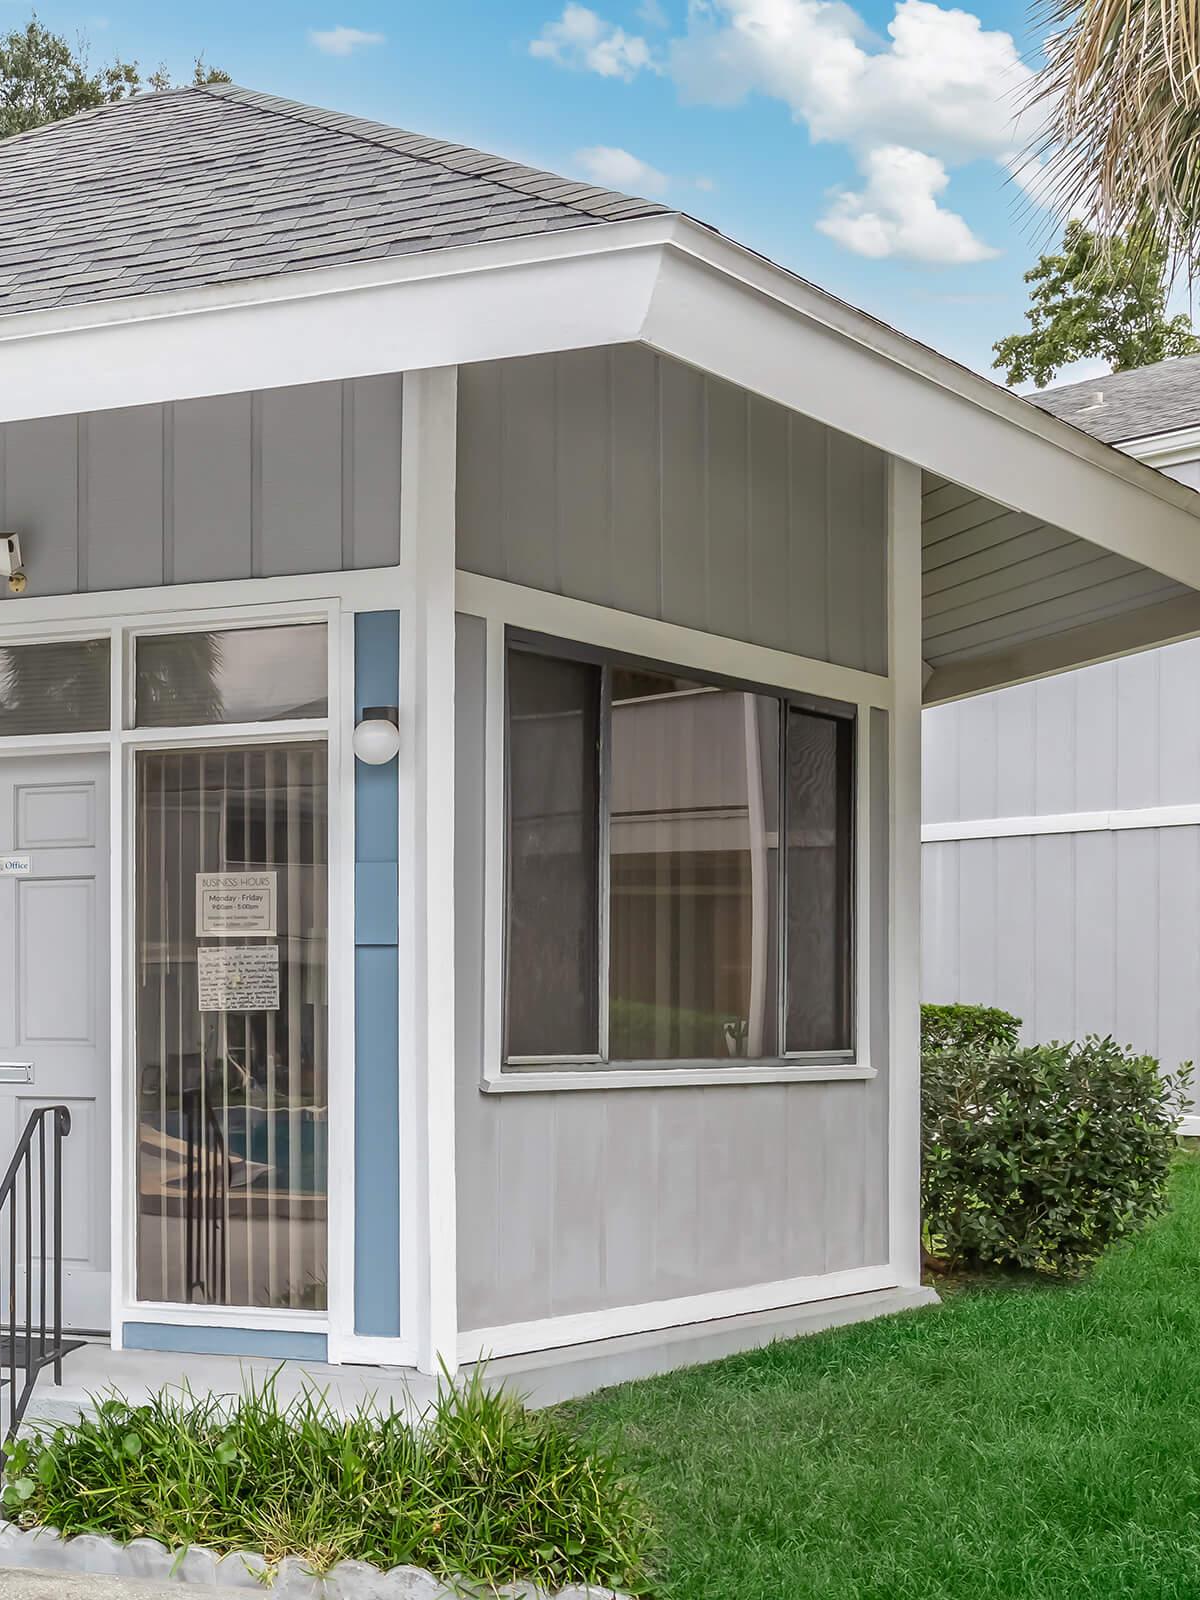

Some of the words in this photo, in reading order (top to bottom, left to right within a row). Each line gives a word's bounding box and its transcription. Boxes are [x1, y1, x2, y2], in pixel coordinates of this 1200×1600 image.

[5, 861, 28, 870] Office
[202, 878, 238, 888] BUSINESS
[241, 877, 270, 887] HOURS
[242, 894, 263, 902] Friday
